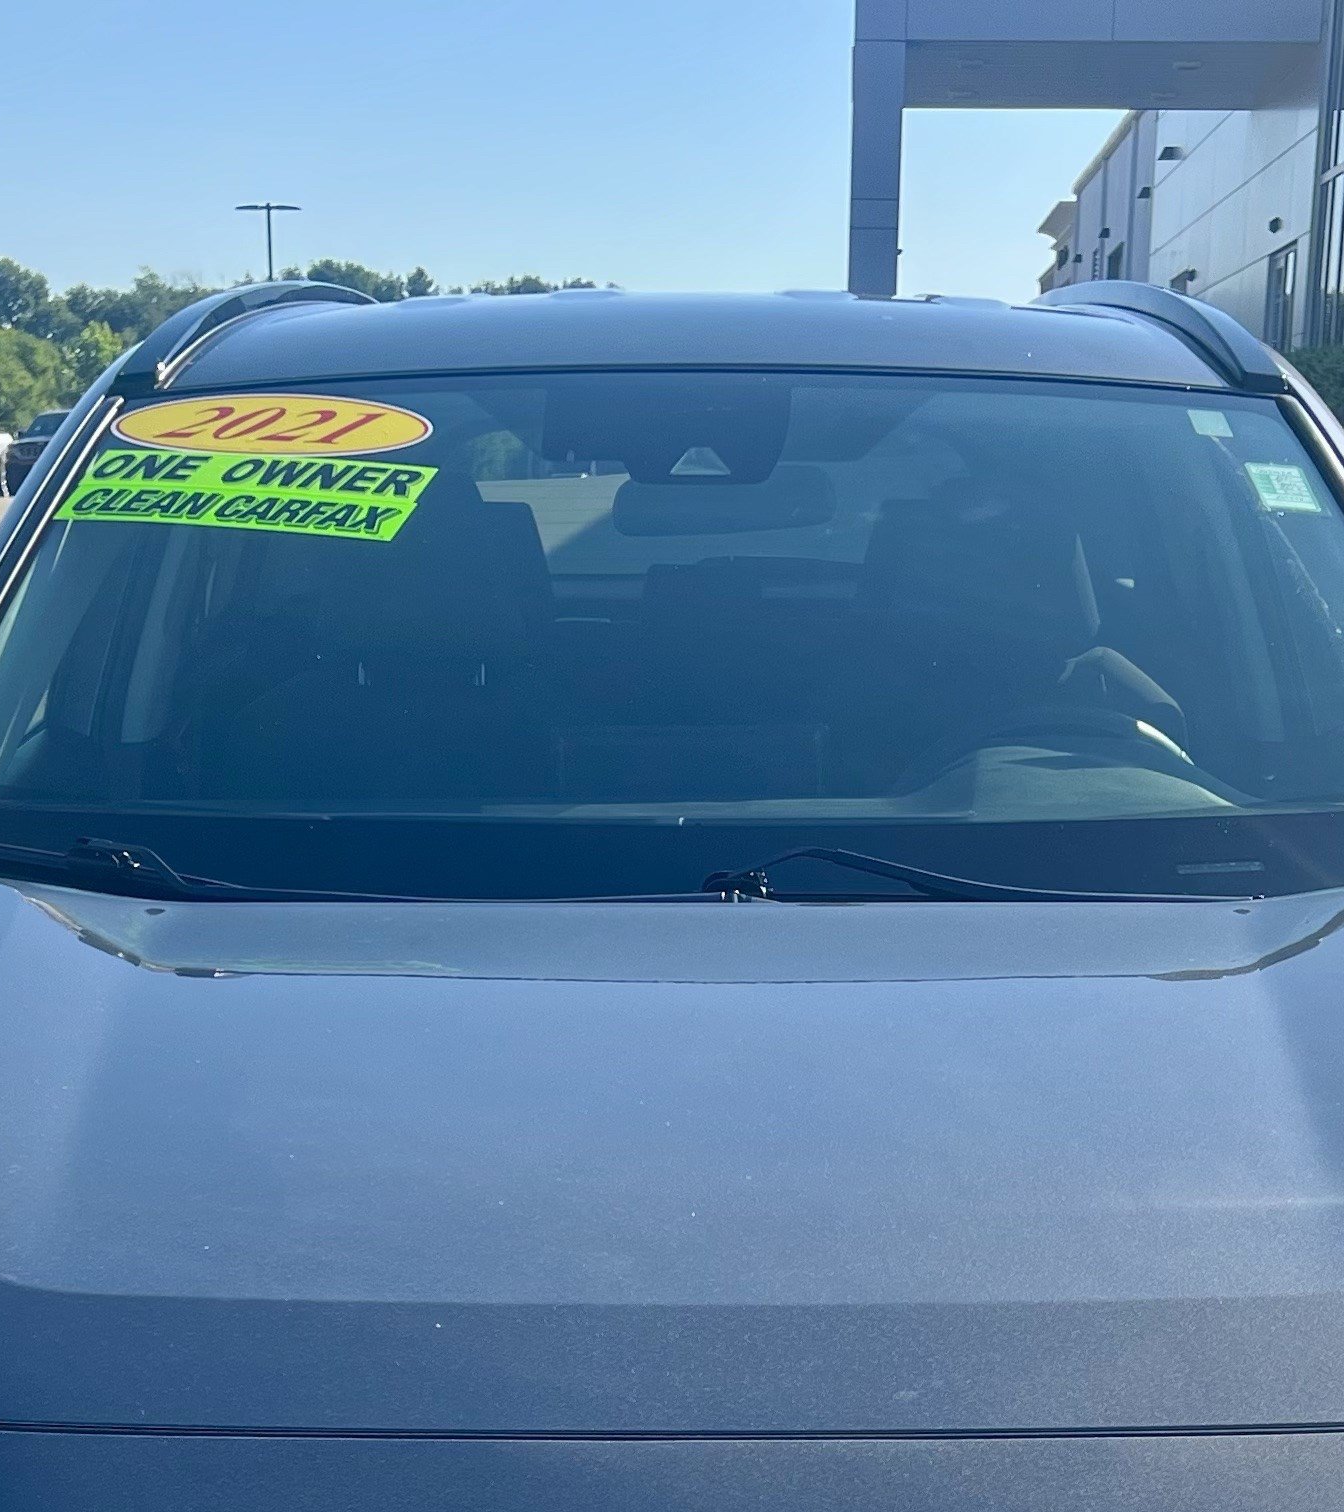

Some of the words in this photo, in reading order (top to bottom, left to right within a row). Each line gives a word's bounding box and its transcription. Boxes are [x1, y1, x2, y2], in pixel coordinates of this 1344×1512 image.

[155, 405, 386, 446] 2021
[92, 454, 209, 482] ONE
[220, 459, 423, 498] OWNER
[71, 487, 212, 518] CLEAN
[213, 492, 398, 534] CARFAX
